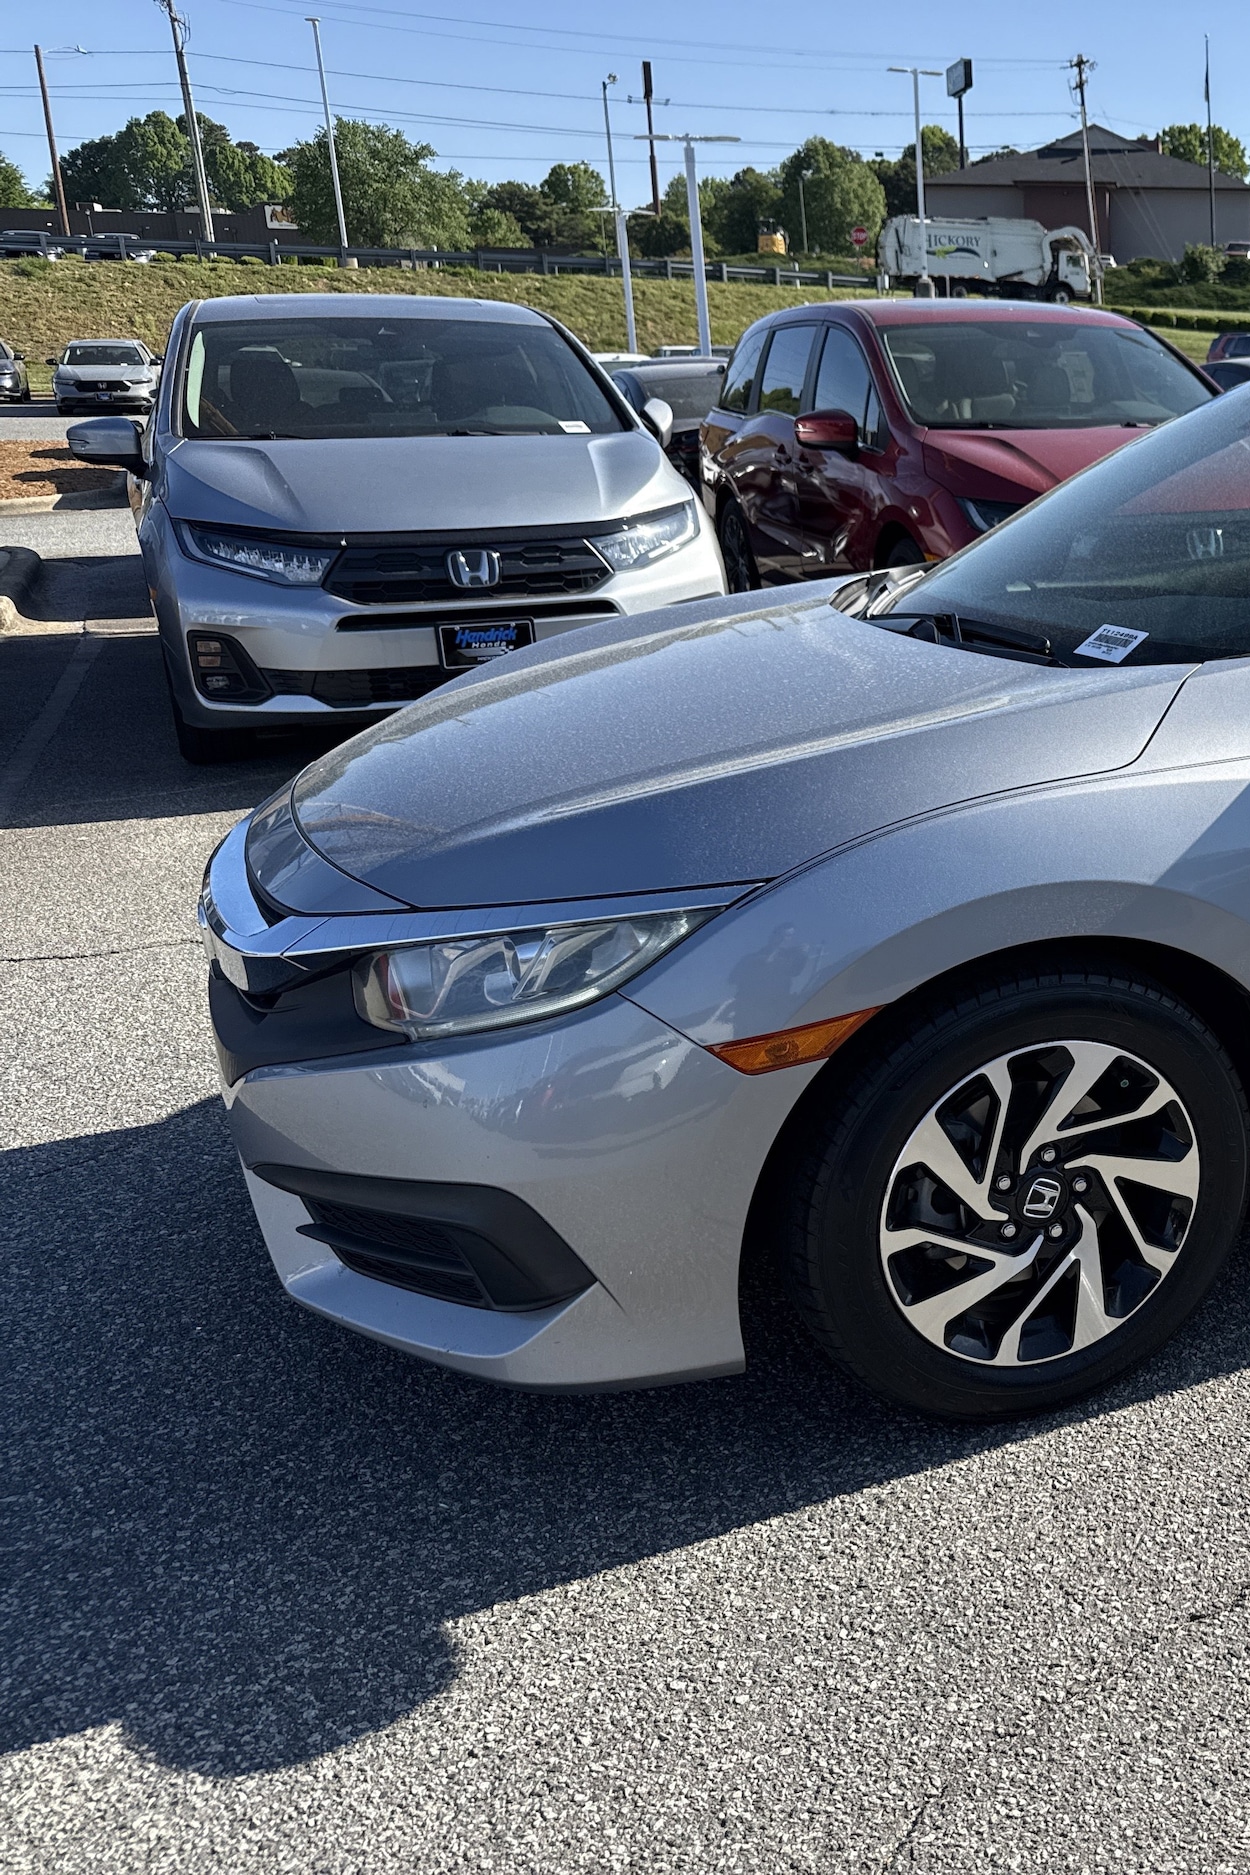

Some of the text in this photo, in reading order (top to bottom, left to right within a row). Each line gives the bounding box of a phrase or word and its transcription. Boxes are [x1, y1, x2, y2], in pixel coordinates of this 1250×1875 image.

[852, 231, 867, 241] STOP
[455, 626, 517, 648] Hendrick
[471, 641, 507, 649] Honda
